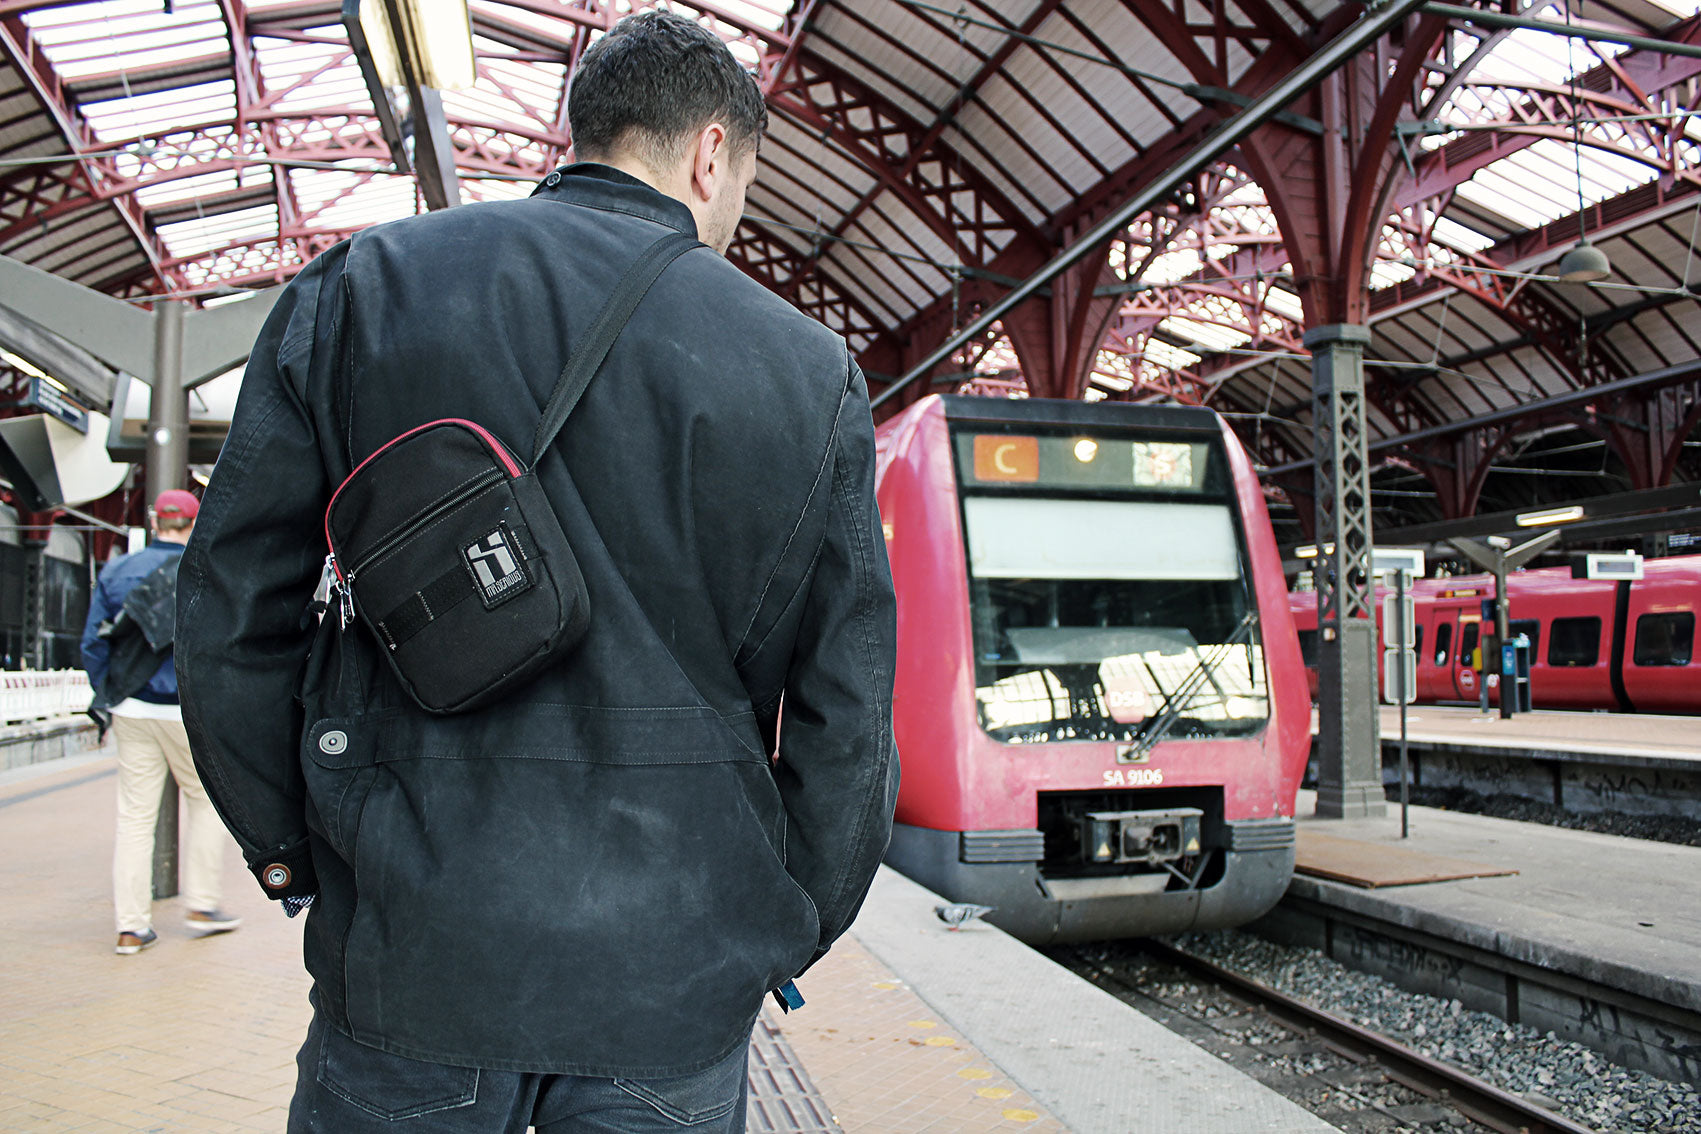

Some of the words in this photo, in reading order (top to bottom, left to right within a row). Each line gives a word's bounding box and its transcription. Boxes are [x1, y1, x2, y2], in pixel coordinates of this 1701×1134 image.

[994, 443, 1018, 475] C
[1109, 690, 1145, 708] DSB
[1103, 770, 1125, 786] SA
[1127, 768, 1163, 786] 9106
